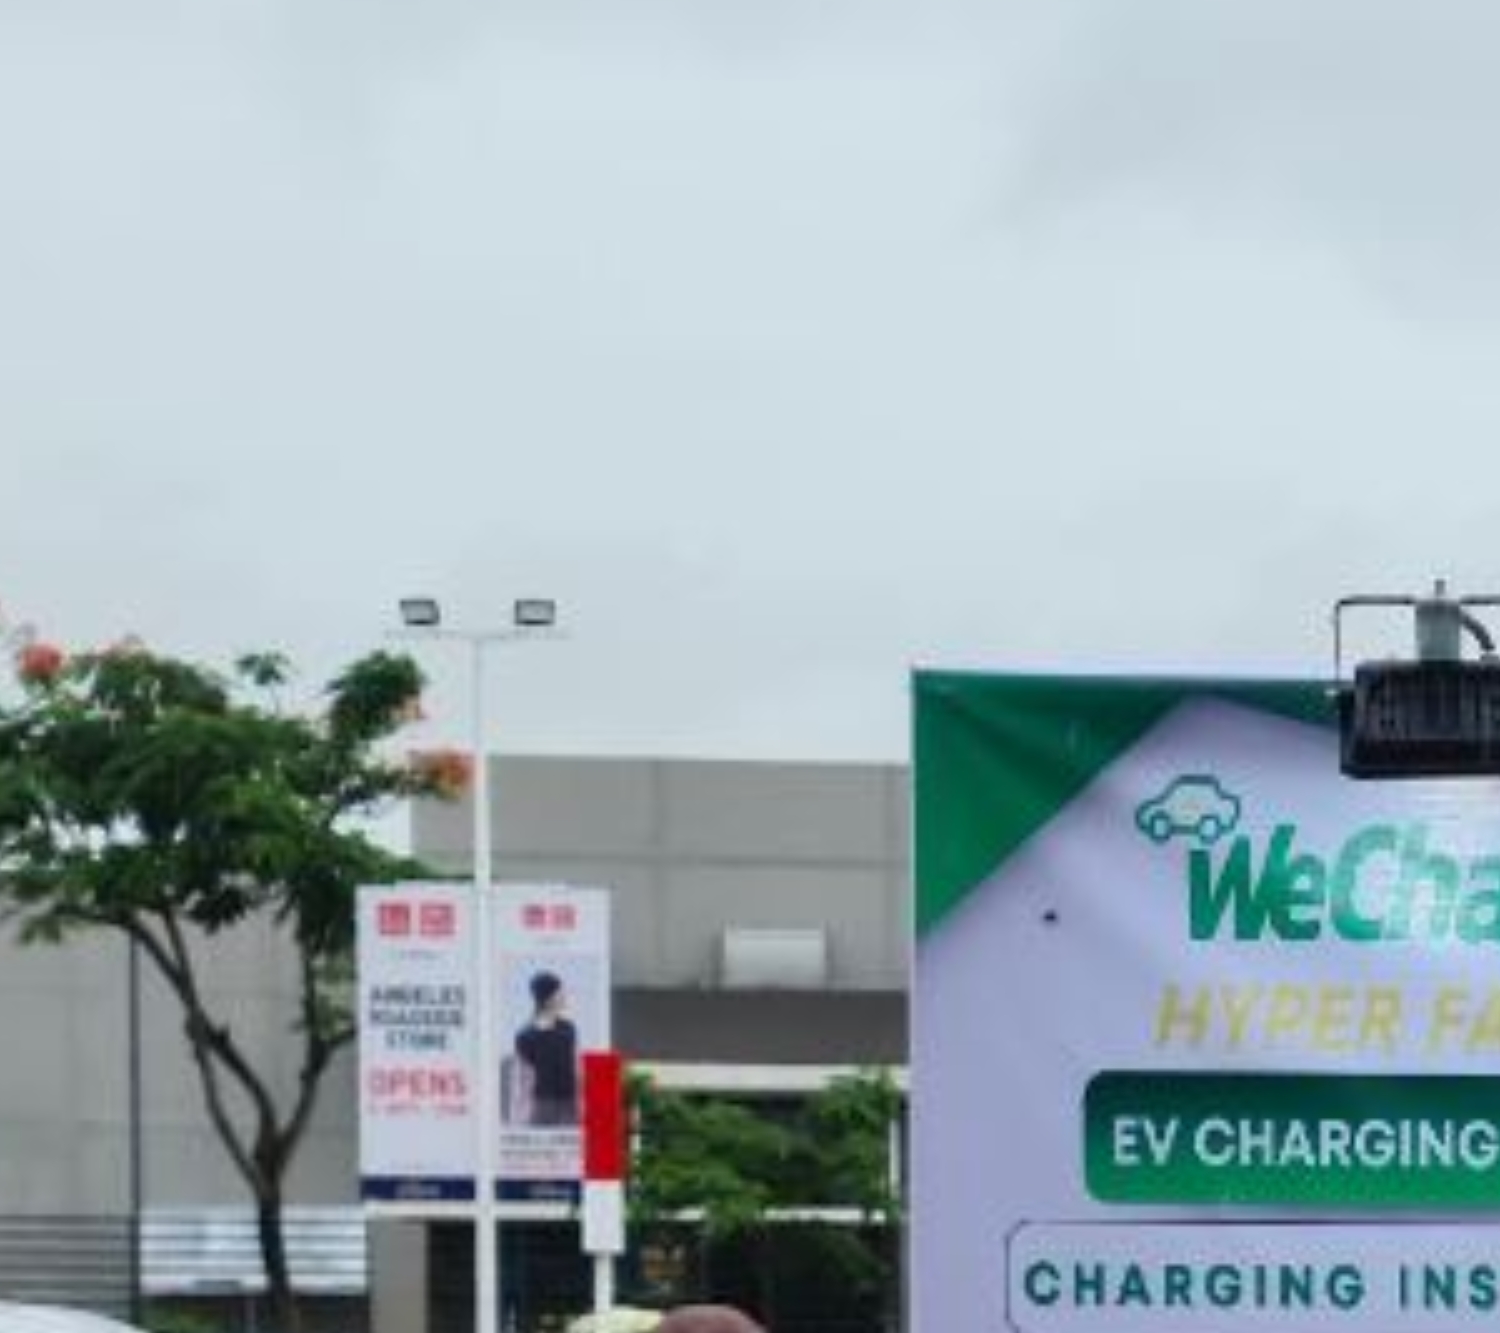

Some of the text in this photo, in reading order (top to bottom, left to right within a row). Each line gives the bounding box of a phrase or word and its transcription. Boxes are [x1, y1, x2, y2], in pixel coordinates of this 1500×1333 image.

[1155, 984, 1403, 1050] HYPER
[369, 1068, 466, 1096] OPENS
[1113, 1117, 1180, 1167] EV
[1193, 1116, 1499, 1169] CHARGING
[1022, 1260, 1365, 1309] CHARGING
